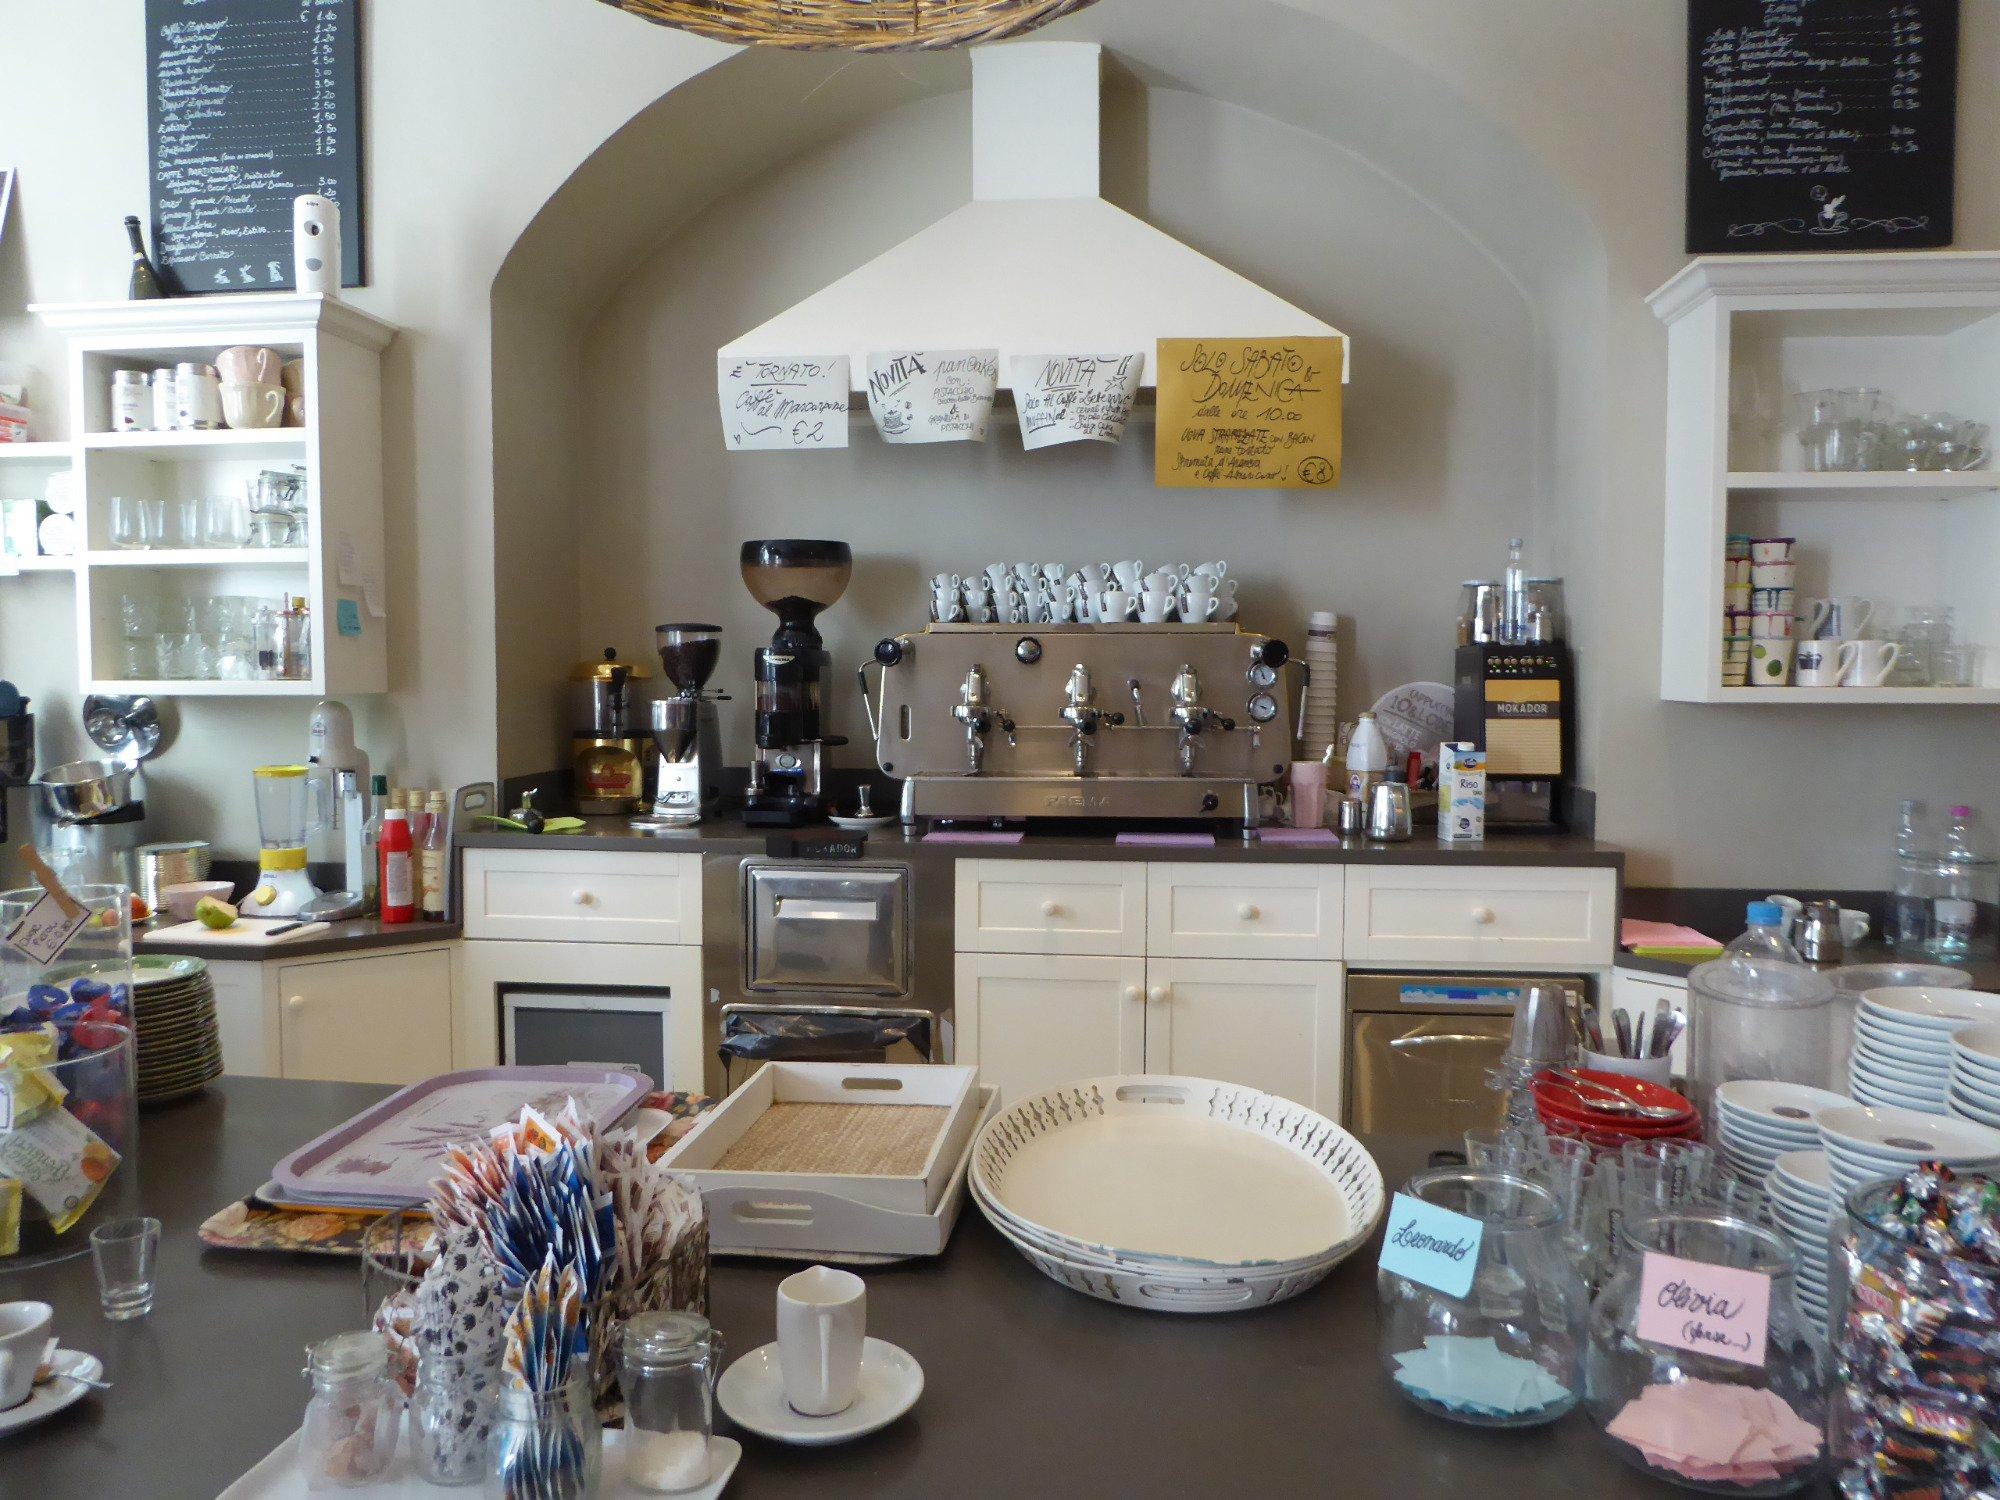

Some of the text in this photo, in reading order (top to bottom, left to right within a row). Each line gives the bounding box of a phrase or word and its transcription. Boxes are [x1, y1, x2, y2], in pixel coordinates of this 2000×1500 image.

[1497, 703, 1549, 714] MOKADOR
[1460, 778, 1480, 790] Riso
[1391, 1218, 1476, 1262] Leonardo
